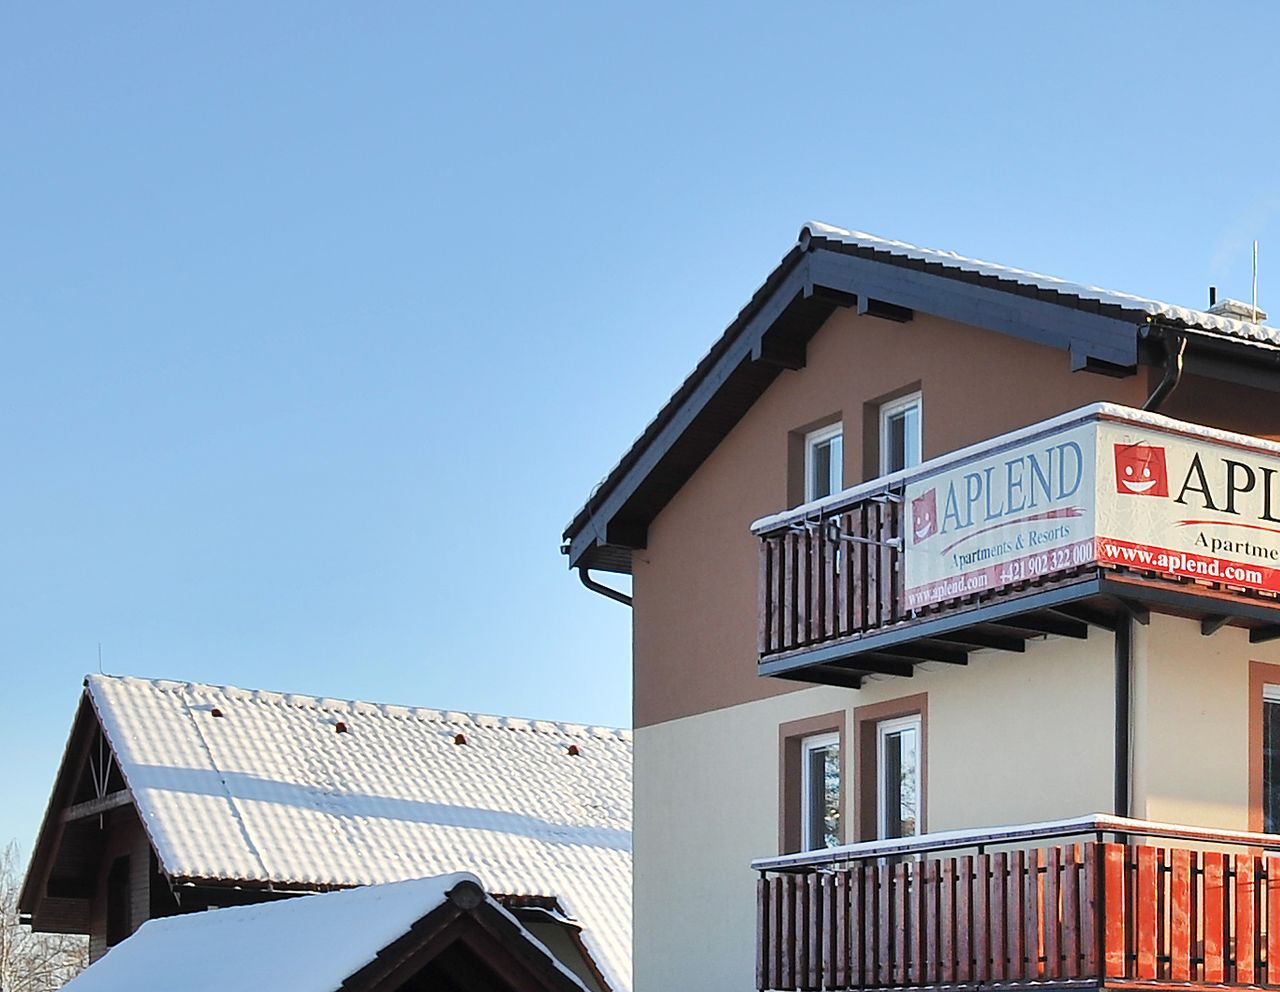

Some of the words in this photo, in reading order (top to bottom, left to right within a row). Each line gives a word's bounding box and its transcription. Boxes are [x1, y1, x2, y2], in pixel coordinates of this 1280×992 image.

[940, 441, 1083, 535] APLEND
[952, 543, 1013, 569] Apartments
[1015, 534, 1025, 550] &
[1028, 525, 1070, 548] Resorts
[1028, 553, 1048, 576] 902
[1050, 547, 1071, 570] 322
[1073, 542, 1093, 563] 000
[1104, 543, 1263, 584] www.aplend.com
[908, 572, 988, 604] www.aplend.com
